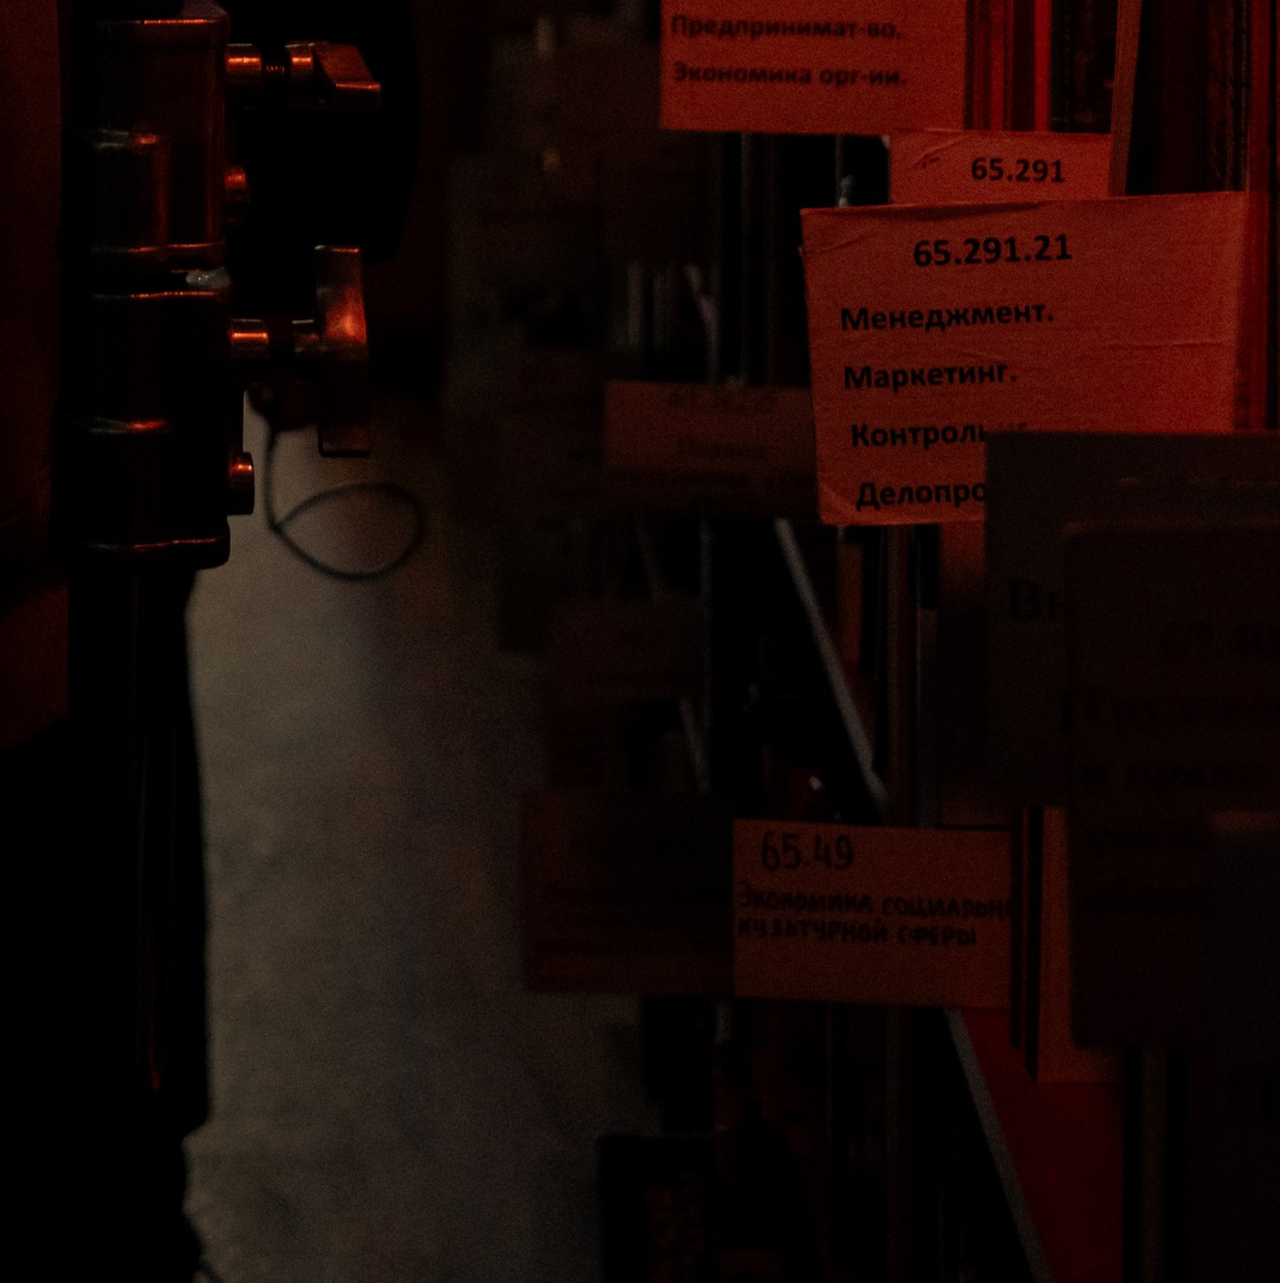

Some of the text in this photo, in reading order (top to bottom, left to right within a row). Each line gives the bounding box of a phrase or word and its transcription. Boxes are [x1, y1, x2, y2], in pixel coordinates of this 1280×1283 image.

[673, 61, 812, 85] Экономика
[970, 157, 1065, 183] 65.291
[913, 234, 1072, 266] 65.291.21
[840, 300, 1054, 333] Менеджмент.
[843, 361, 1016, 392] Маркетинг.
[856, 482, 987, 511] Делопро
[761, 831, 854, 871] 65.49
